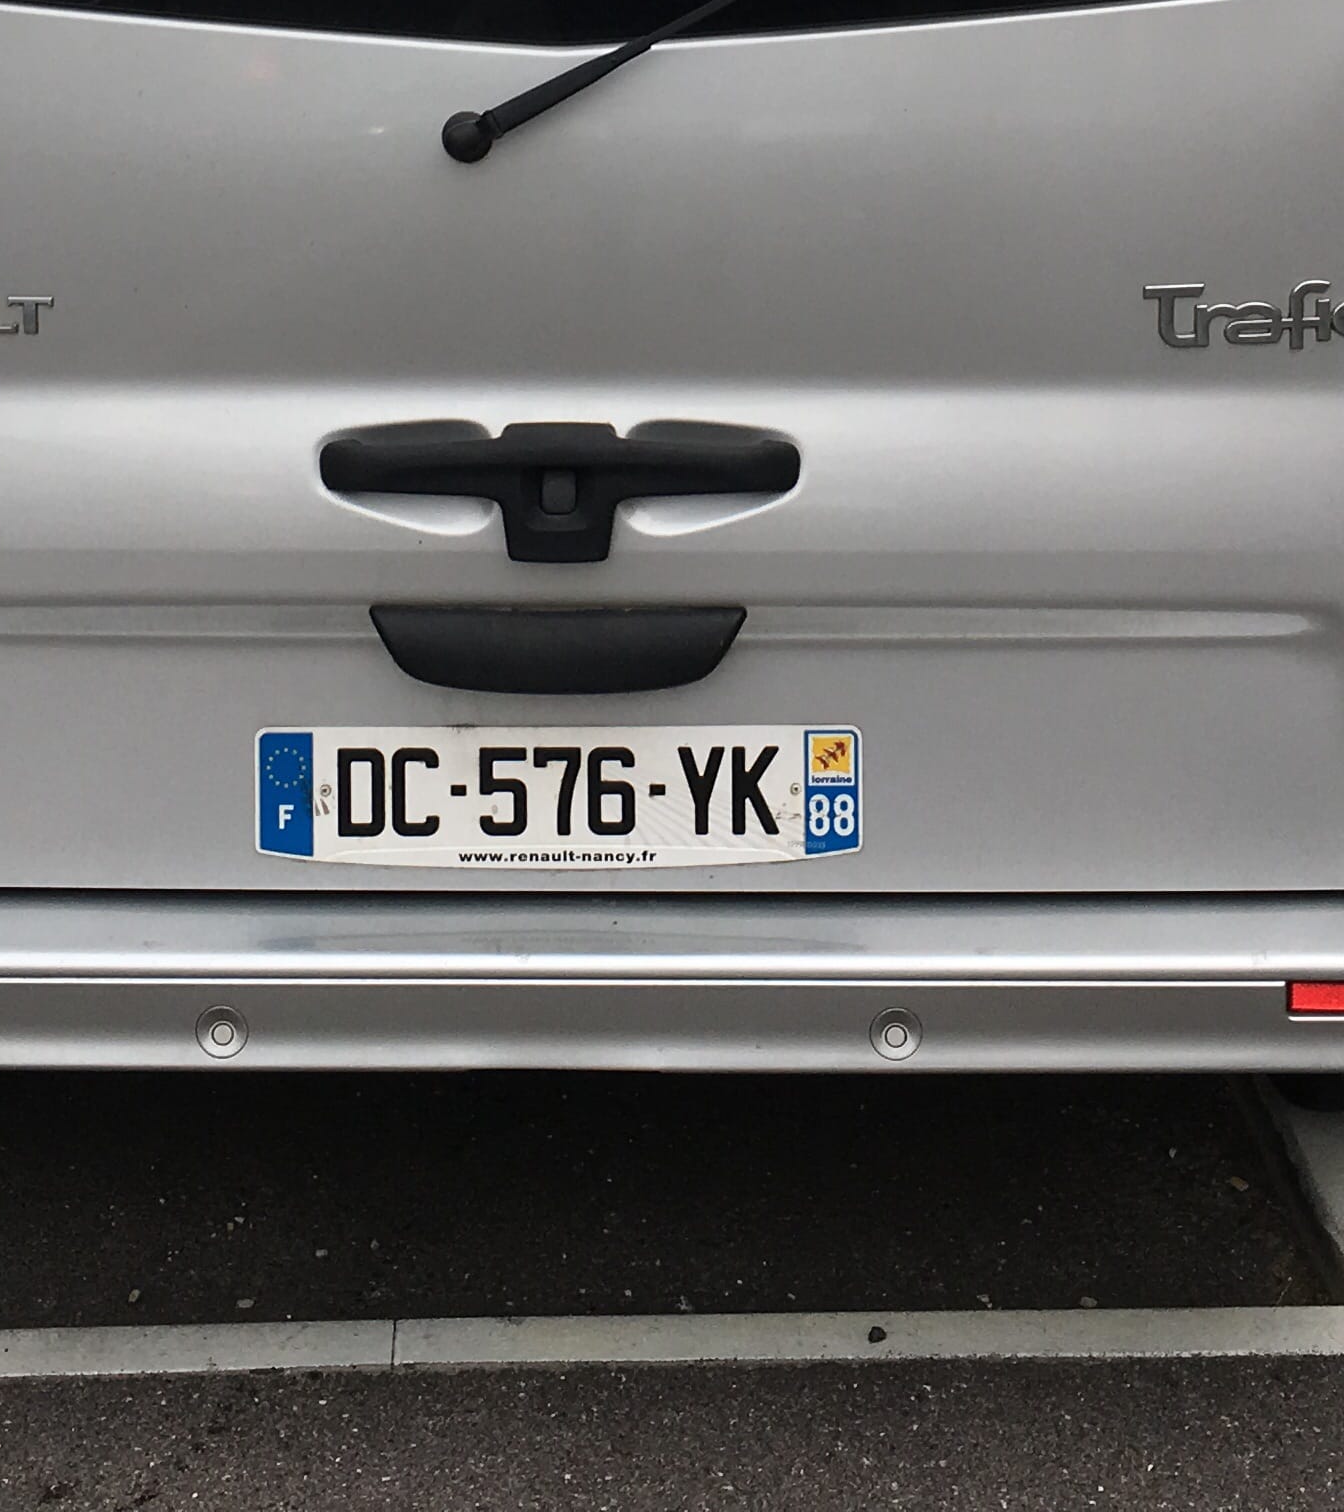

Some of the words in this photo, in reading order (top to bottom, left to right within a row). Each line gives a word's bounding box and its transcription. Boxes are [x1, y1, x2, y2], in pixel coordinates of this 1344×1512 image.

[337, 746, 780, 838] DC-576-YK
[278, 805, 295, 830] F
[808, 793, 856, 837] 88
[458, 848, 657, 867] www.renault-nancy.fr
